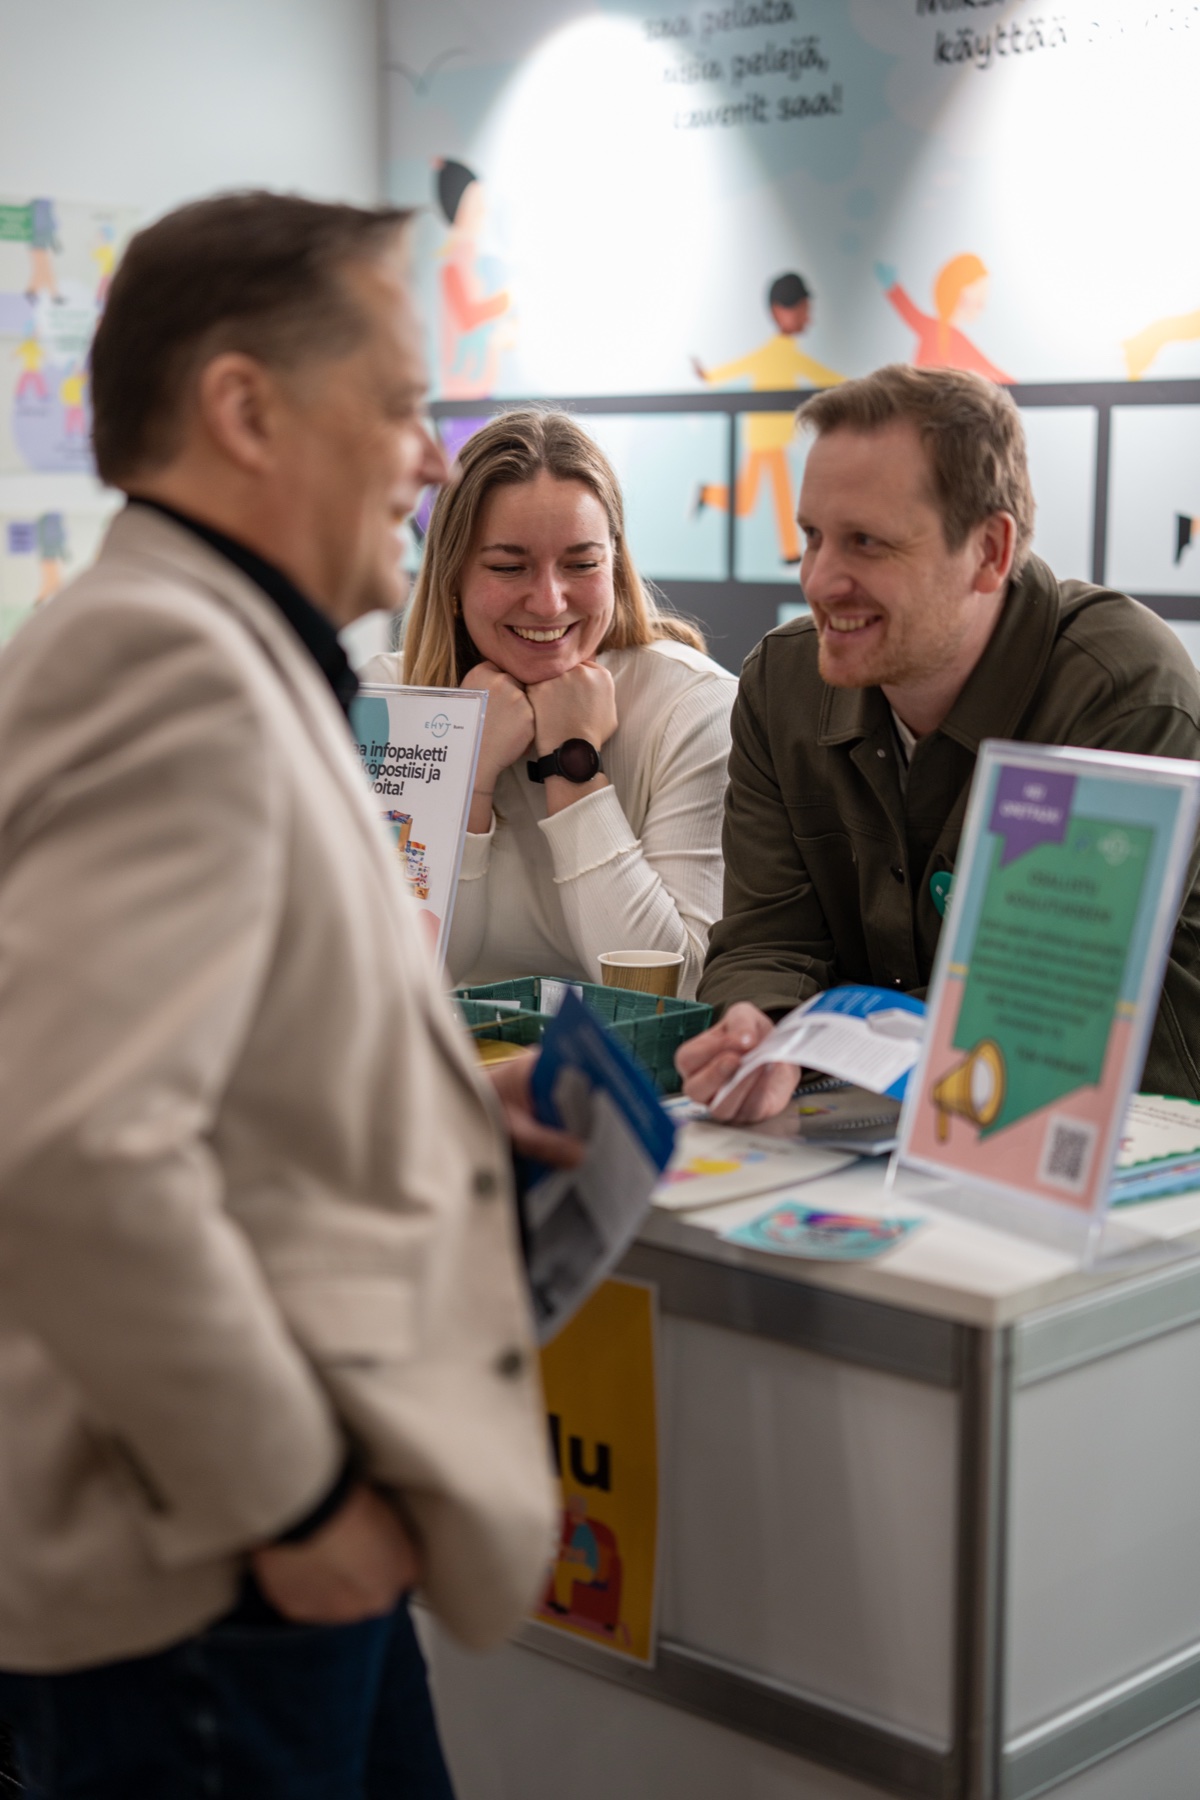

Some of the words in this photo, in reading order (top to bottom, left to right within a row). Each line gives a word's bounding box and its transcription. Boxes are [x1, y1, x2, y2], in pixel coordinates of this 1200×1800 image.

[934, 16, 1068, 68] käyttää
[370, 740, 449, 763] infopaketti
[425, 763, 441, 784] ja
